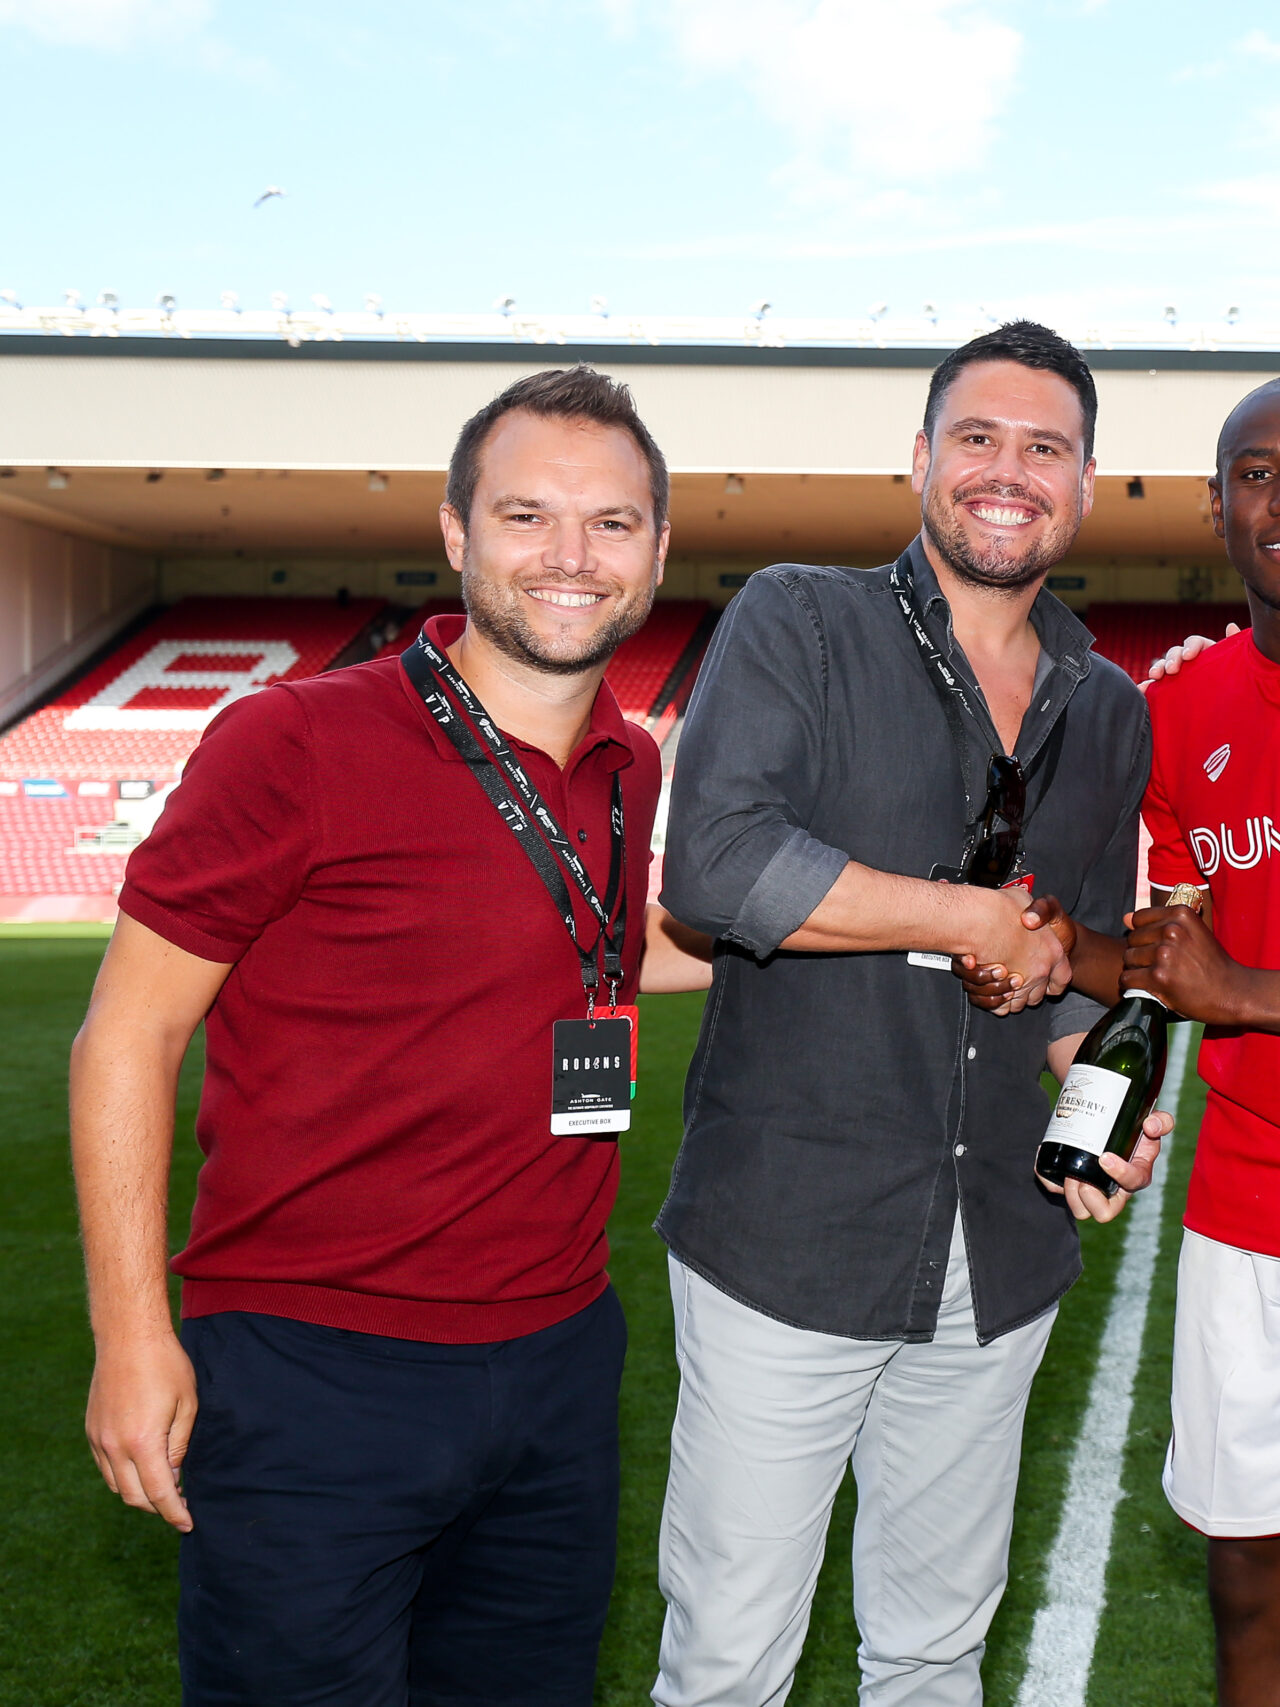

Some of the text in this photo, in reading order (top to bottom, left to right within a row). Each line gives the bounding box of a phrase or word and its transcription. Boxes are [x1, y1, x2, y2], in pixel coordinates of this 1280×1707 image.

[446, 674, 474, 709] ASHTON GATE
[425, 694, 450, 723] VIP
[505, 760, 531, 798] ASHTON GATE
[497, 800, 523, 832] VIP
[562, 850, 586, 887] ASHTON GATE
[1065, 1096, 1108, 1114] RESERVE
